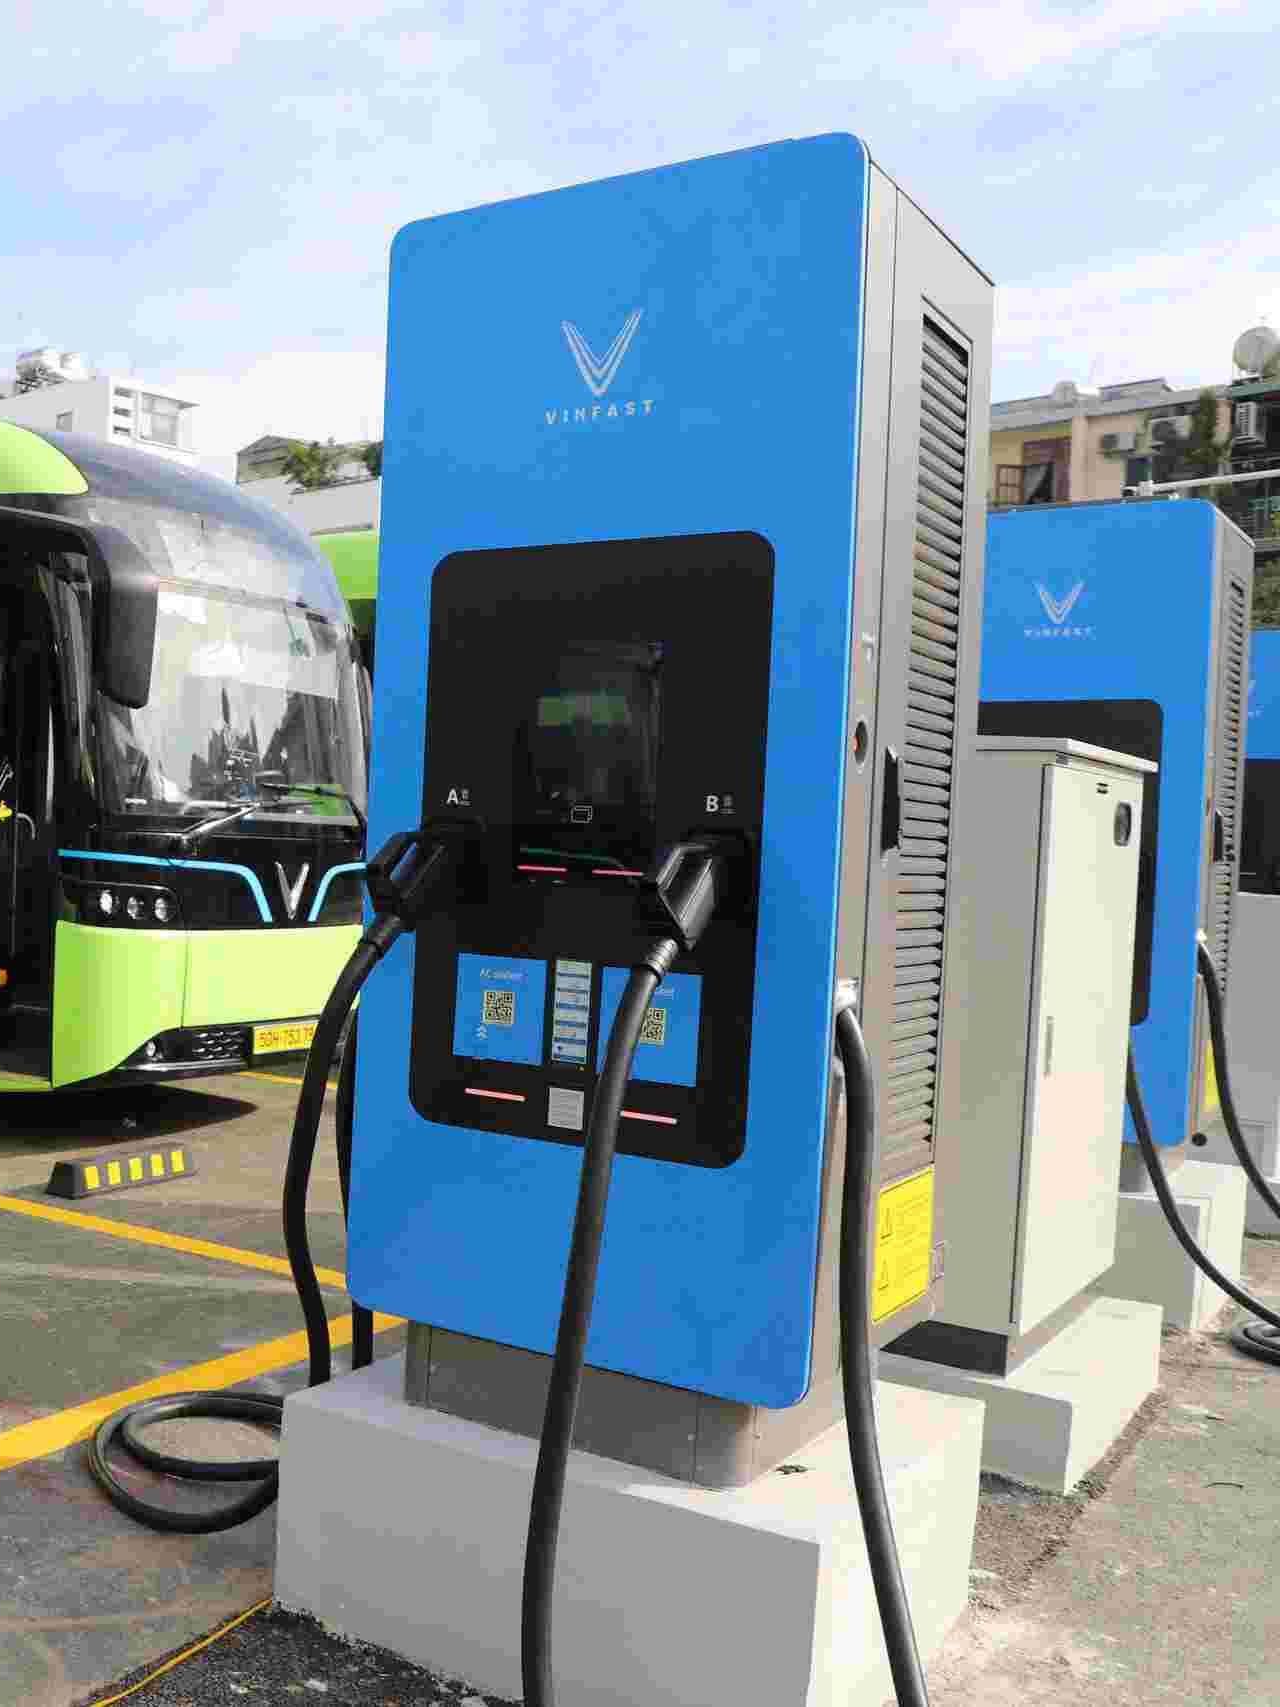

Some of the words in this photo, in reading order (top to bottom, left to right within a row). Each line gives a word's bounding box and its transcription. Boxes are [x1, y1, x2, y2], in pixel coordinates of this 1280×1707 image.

[545, 400, 656, 423] VINFAST
[446, 788, 459, 806] A
[705, 795, 719, 812] B
